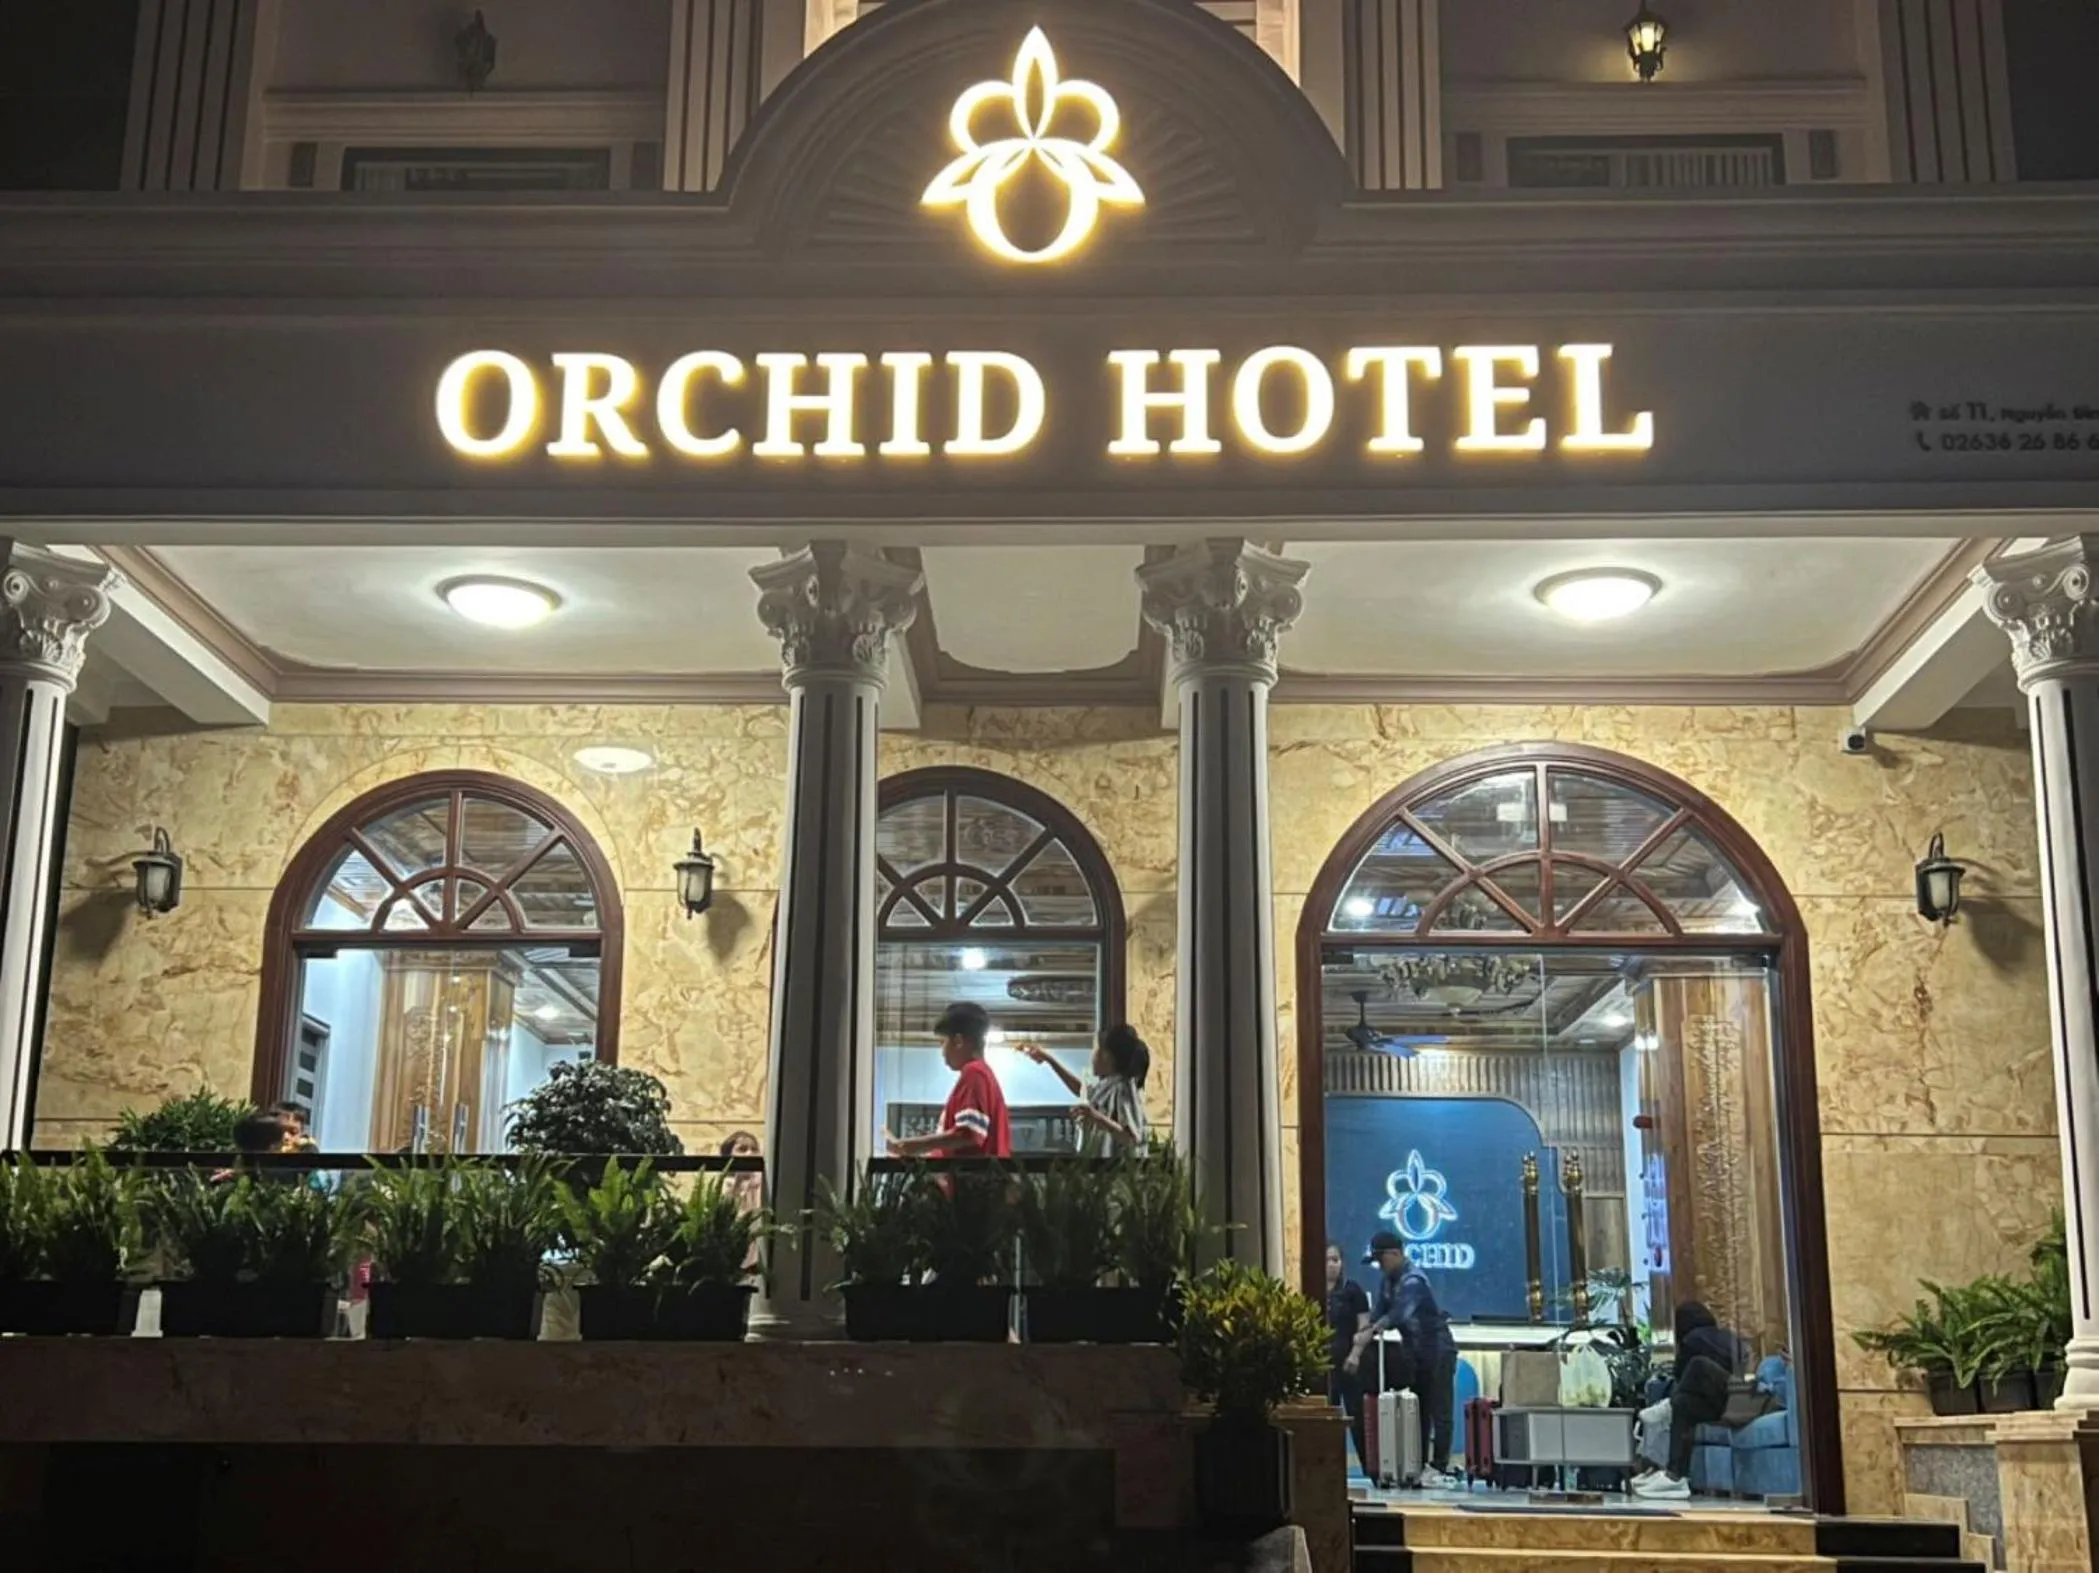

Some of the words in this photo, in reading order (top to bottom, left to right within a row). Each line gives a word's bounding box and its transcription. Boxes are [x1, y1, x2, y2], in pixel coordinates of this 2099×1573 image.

[435, 349, 1046, 458] ORCHID
[1106, 343, 1655, 455] HOTEL
[2018, 432, 2046, 451] 26
[1365, 1243, 1476, 1269] CHID
